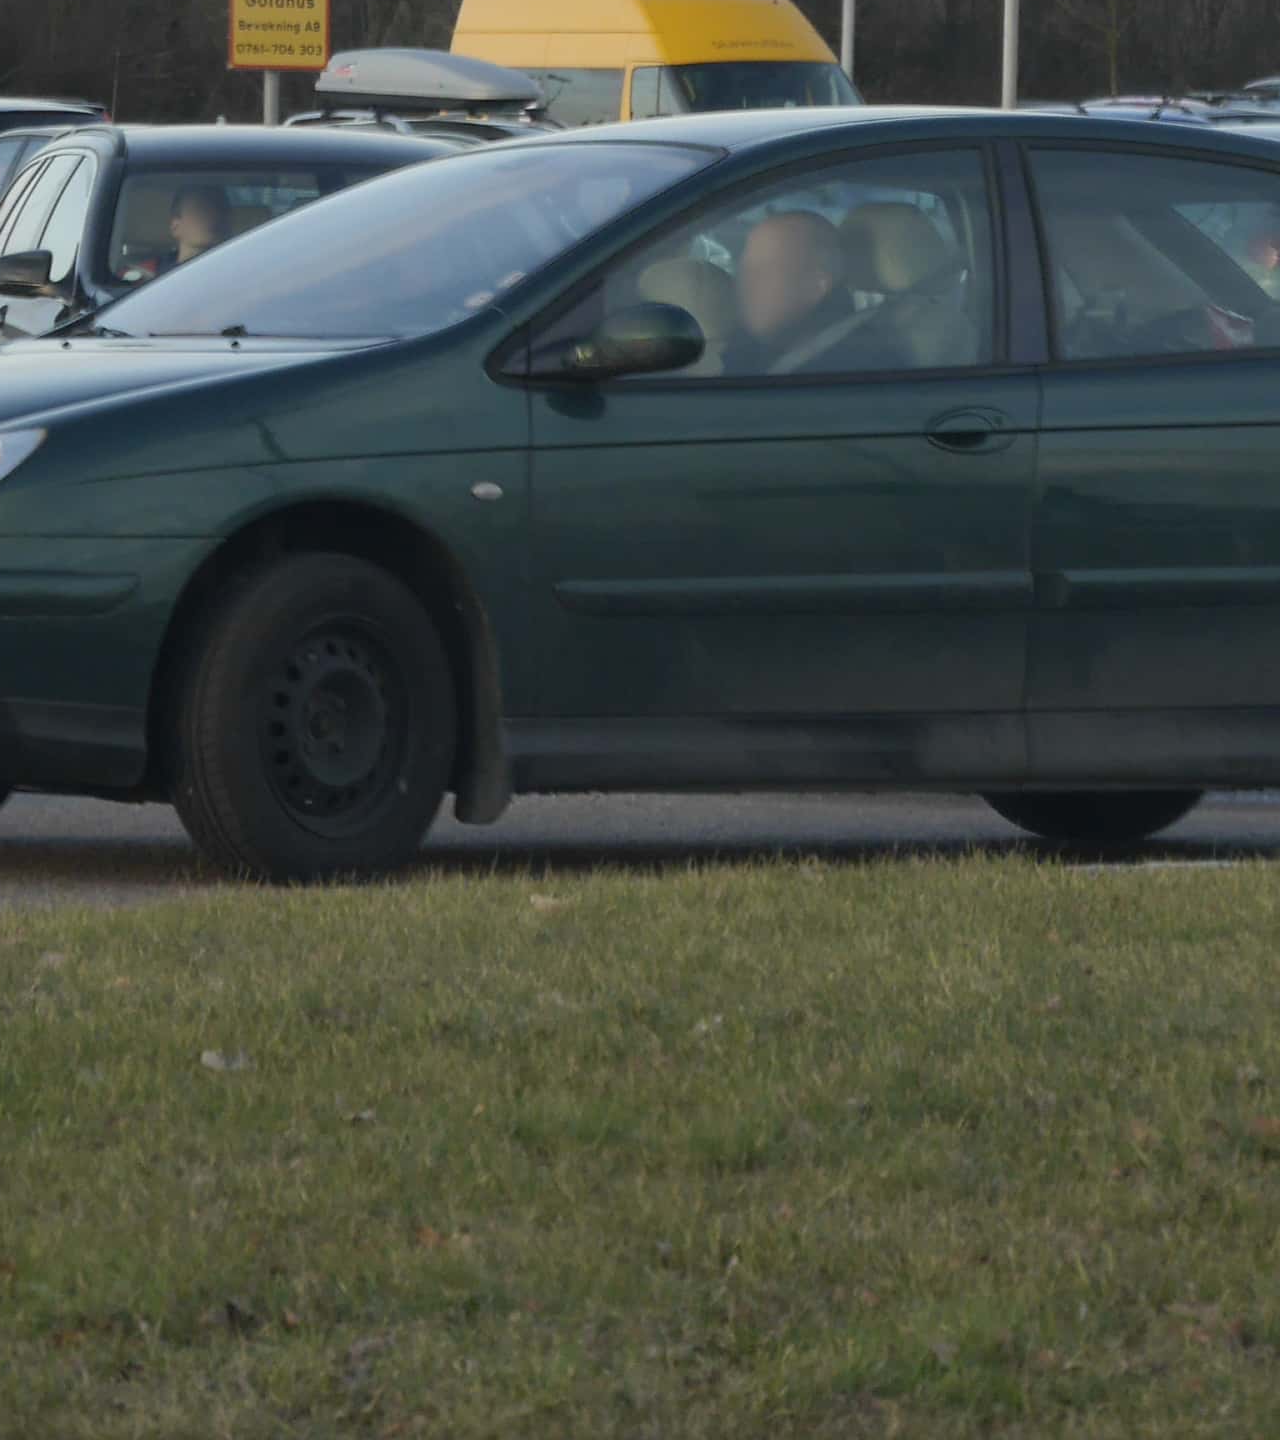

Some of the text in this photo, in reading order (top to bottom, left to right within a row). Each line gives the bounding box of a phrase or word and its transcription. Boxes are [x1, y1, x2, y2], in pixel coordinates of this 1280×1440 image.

[238, 19, 321, 35] Bevakning AB
[299, 44, 323, 56] 303
